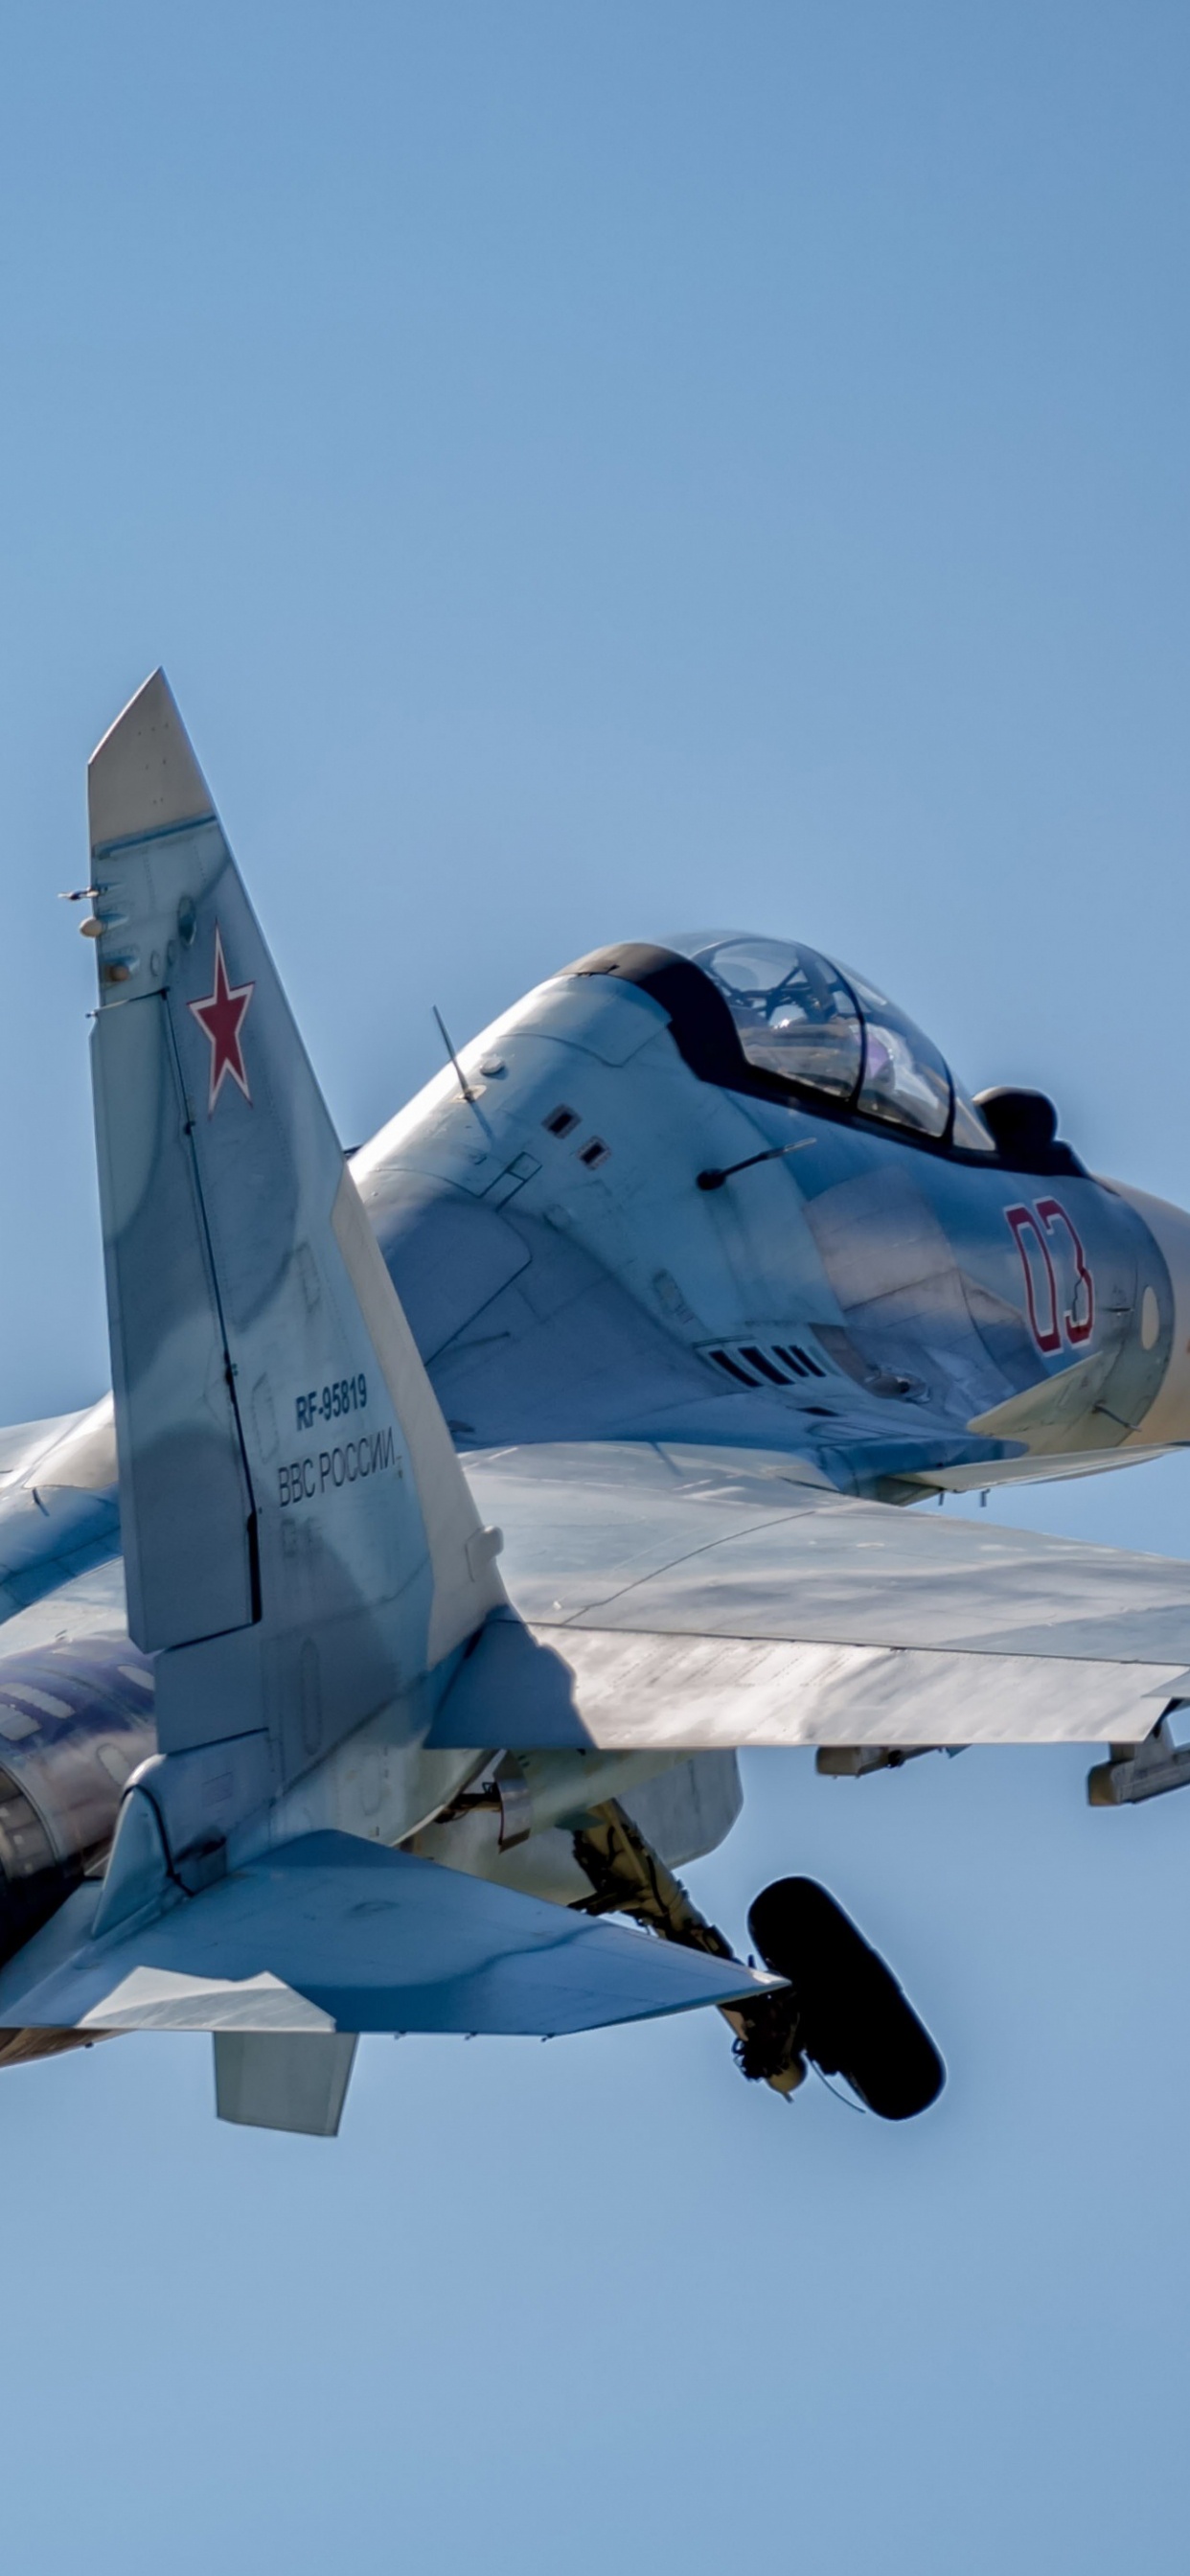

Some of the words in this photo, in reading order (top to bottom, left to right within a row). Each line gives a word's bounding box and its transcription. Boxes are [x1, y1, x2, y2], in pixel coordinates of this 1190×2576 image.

[1003, 1196, 1093, 1357] 03
[296, 1373, 368, 1432] RF-95819
[278, 1458, 316, 1508] ВВС
[319, 1426, 395, 1493] РОССИИ
